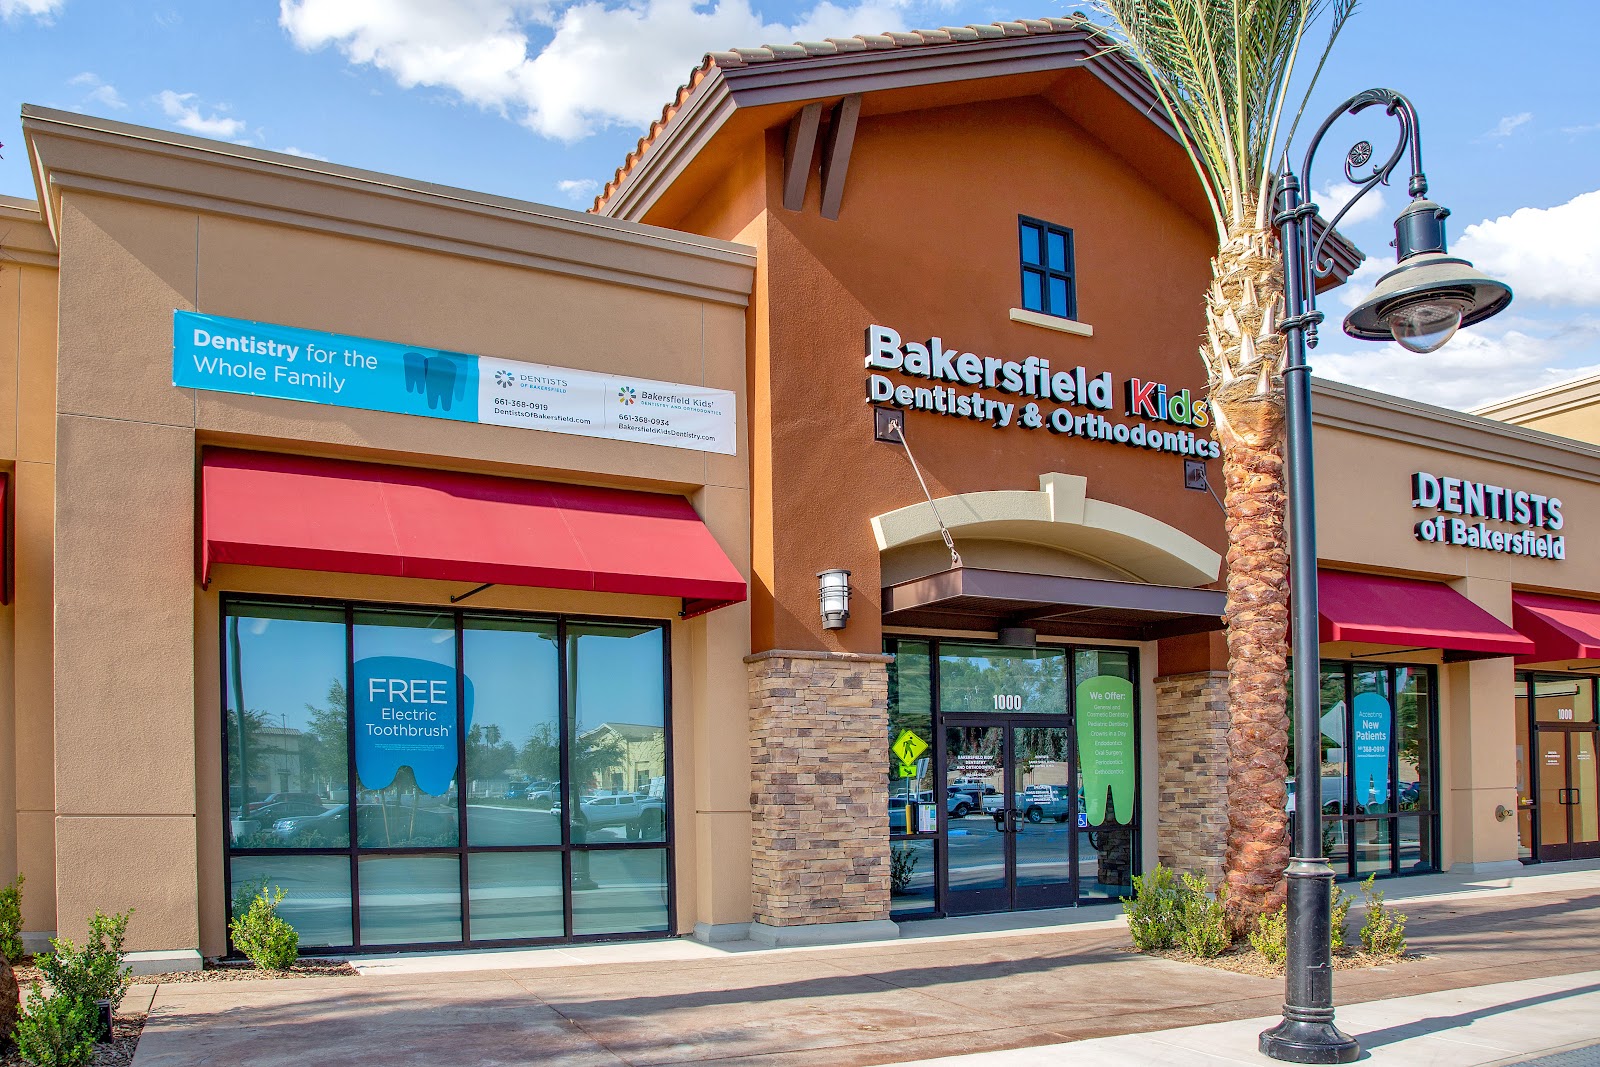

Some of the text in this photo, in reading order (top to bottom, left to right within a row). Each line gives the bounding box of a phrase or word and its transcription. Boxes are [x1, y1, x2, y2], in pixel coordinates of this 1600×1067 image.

[193, 328, 378, 370] Dentistry for the
[193, 354, 346, 394] Whole Family
[865, 323, 1113, 410] Bakersfield
[520, 374, 568, 387] DENTISTS
[529, 384, 567, 394] BAKERSFIELD
[494, 398, 549, 411] 661-368-0919
[641, 391, 714, 408] Bakersfield Kids'
[494, 407, 591, 425] DentistsOfBakersfield.com
[641, 400, 669, 408] DENTISTRY
[682, 406, 722, 416] ORTHODONTICS
[867, 373, 1221, 459] Dentistry & Orthodontics
[618, 413, 670, 427] 661-368-0934
[618, 422, 716, 442] BakersfieldKidsDentistry.com
[1412, 471, 1564, 531] DENTISTS
[1418, 515, 1566, 561] of Bakersfield
[368, 677, 448, 705] FREE
[1089, 691, 1126, 700] We Offer:
[992, 694, 1022, 711] 1000
[381, 707, 437, 721] Electric
[1358, 711, 1383, 719] Accepting
[1558, 708, 1573, 720] 1000
[1362, 719, 1380, 729] New
[1355, 730, 1387, 741] Patients
